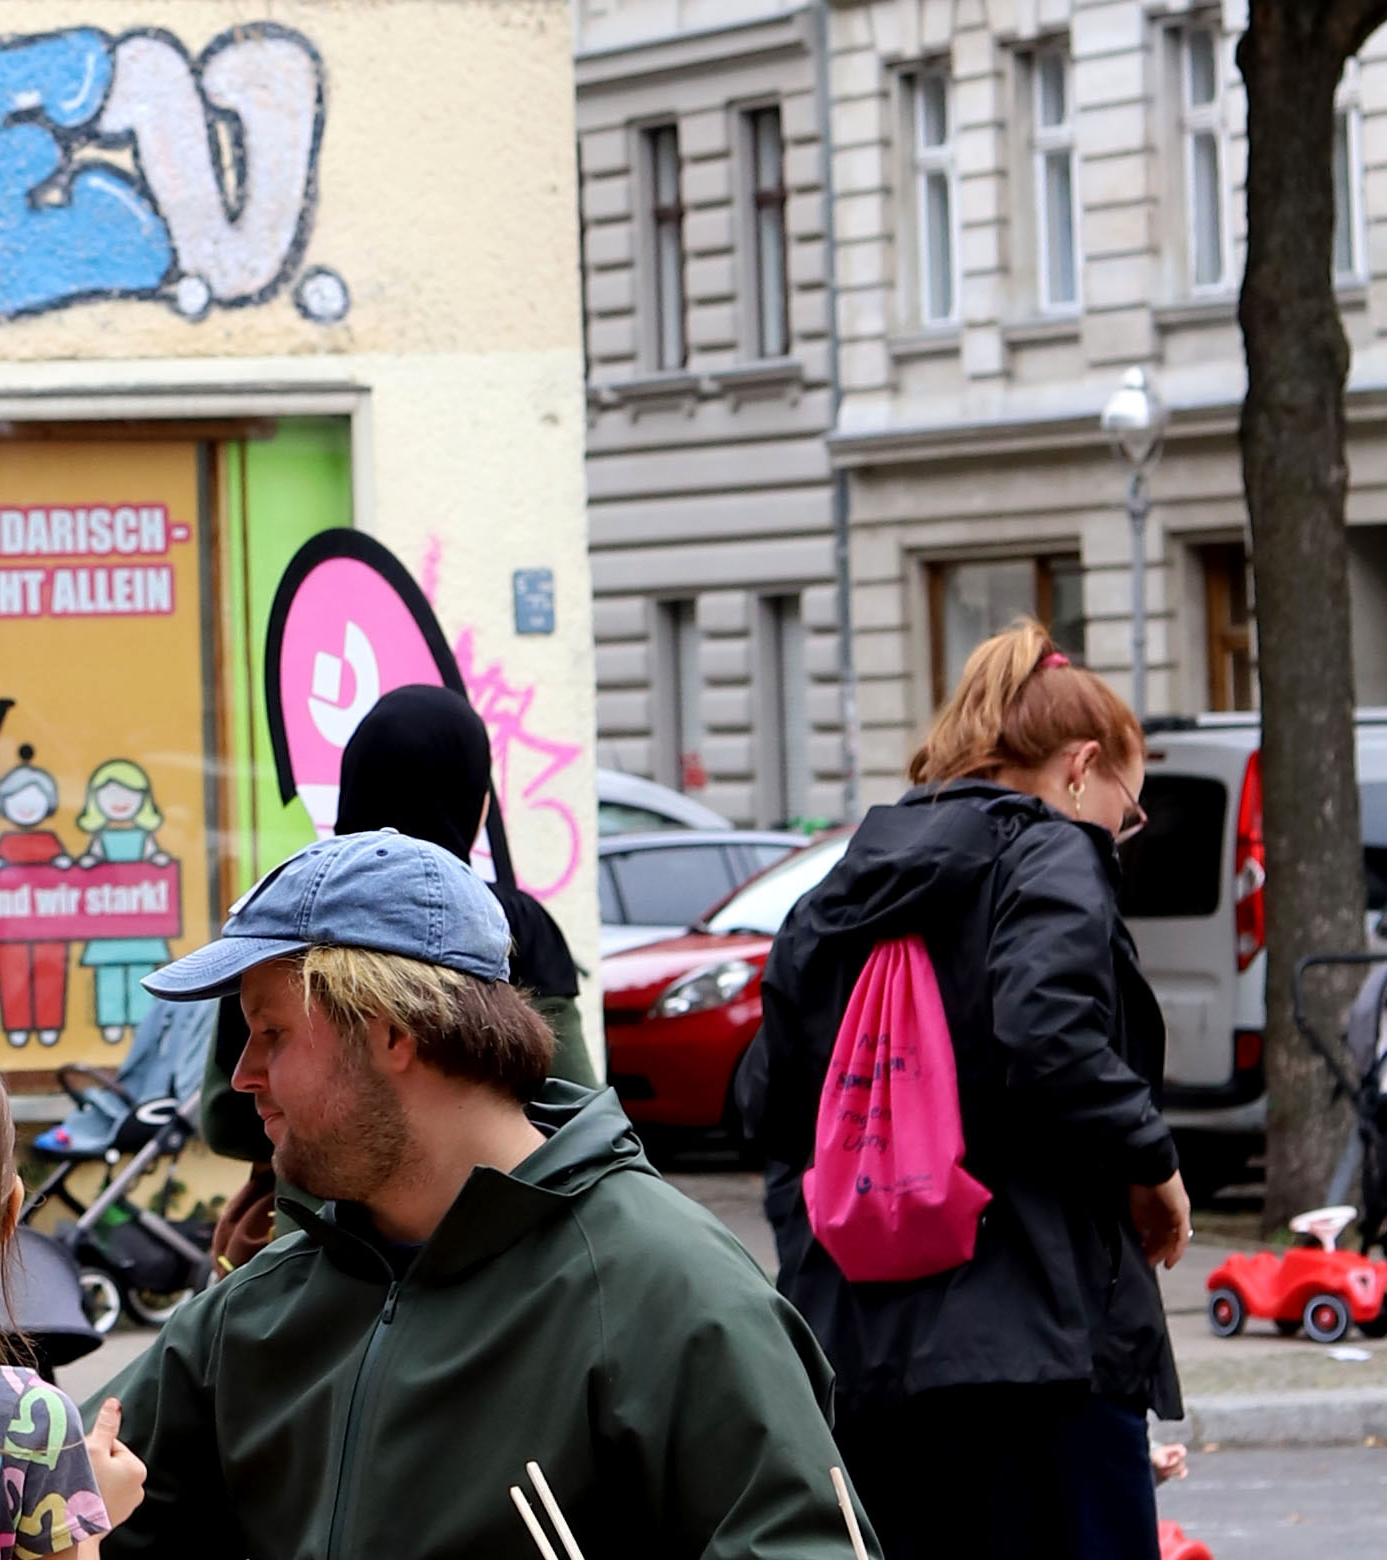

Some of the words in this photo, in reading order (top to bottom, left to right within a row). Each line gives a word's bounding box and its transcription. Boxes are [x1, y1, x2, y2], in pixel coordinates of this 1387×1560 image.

[49, 567, 173, 616] ALLEIN
[34, 883, 80, 917] wir
[84, 879, 170, 916] stark!
